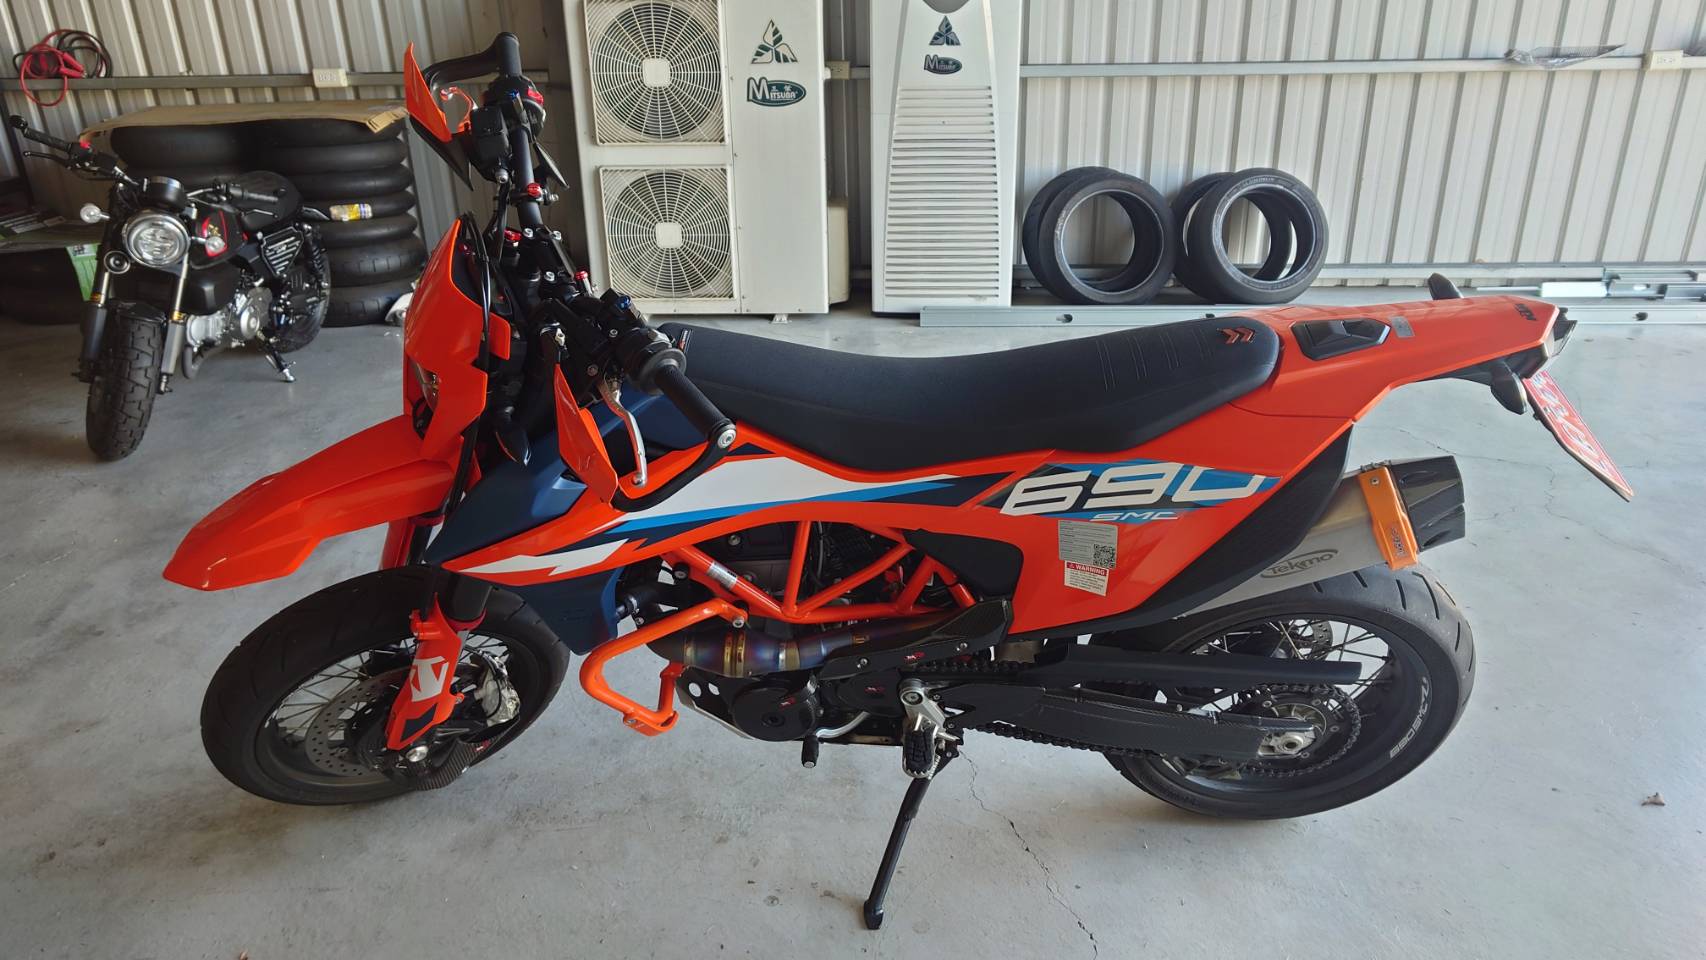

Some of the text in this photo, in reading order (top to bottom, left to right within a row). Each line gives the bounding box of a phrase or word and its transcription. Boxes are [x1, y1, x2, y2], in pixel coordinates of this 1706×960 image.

[1090, 511, 1179, 522] SMC
[1075, 564, 1105, 576] WARNING
[1270, 553, 1334, 575] Tekmo
